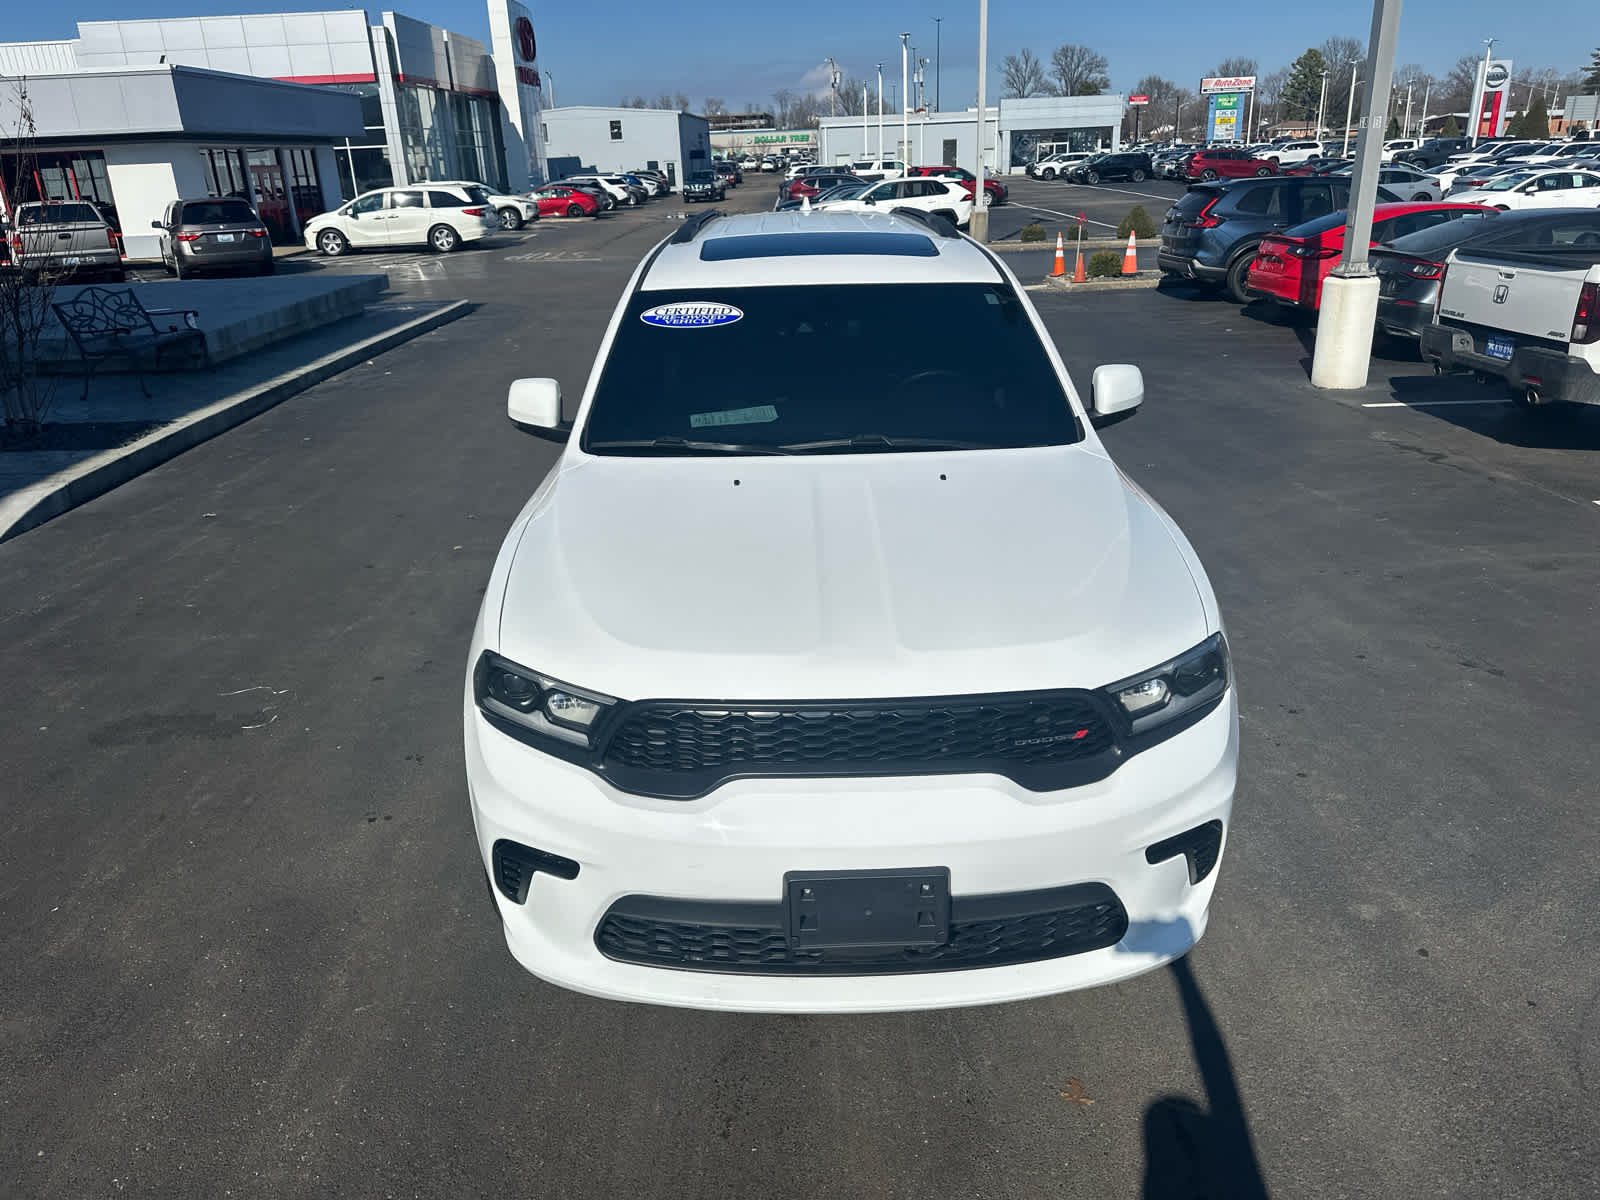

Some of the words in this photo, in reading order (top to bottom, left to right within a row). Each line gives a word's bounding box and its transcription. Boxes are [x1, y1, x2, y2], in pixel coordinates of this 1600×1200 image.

[1213, 79, 1252, 87] AutoZone
[754, 135, 786, 144] DOLLAR
[790, 134, 809, 142] TREE
[654, 307, 733, 316] CERTIFIED
